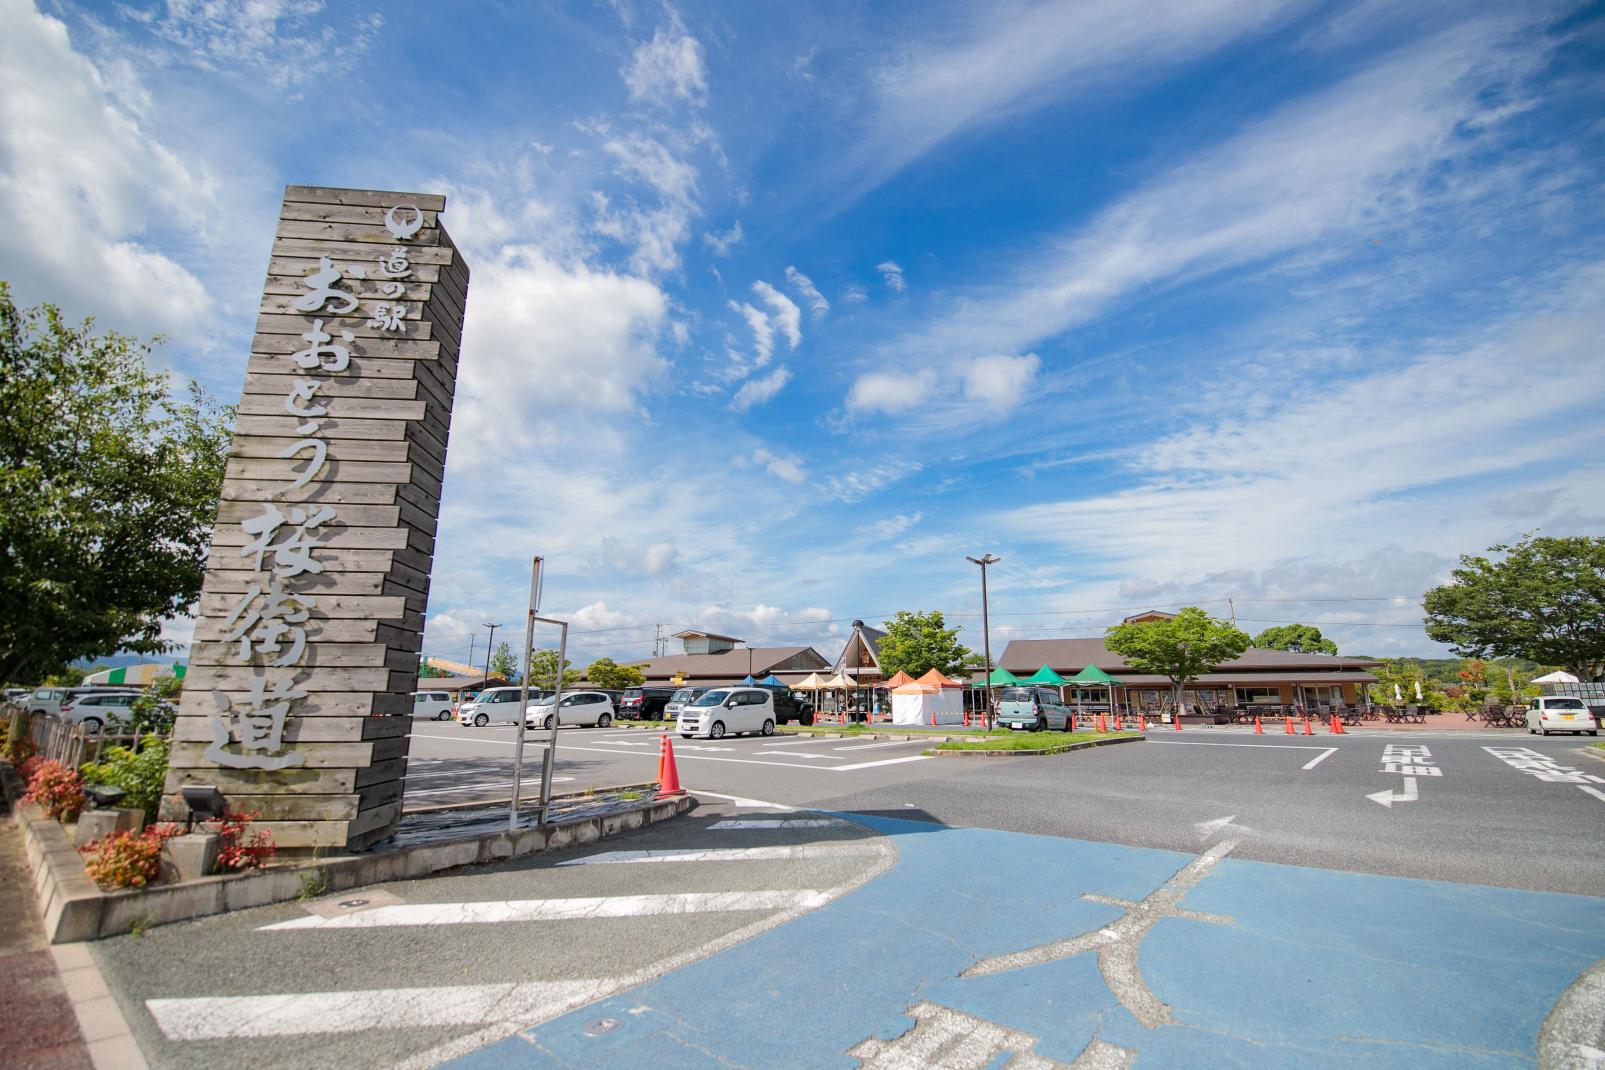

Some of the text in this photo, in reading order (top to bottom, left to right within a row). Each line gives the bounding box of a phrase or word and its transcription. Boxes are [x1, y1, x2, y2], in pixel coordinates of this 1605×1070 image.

[367, 246, 412, 333] 道の駅
[203, 257, 366, 771] おおとう桜街道
